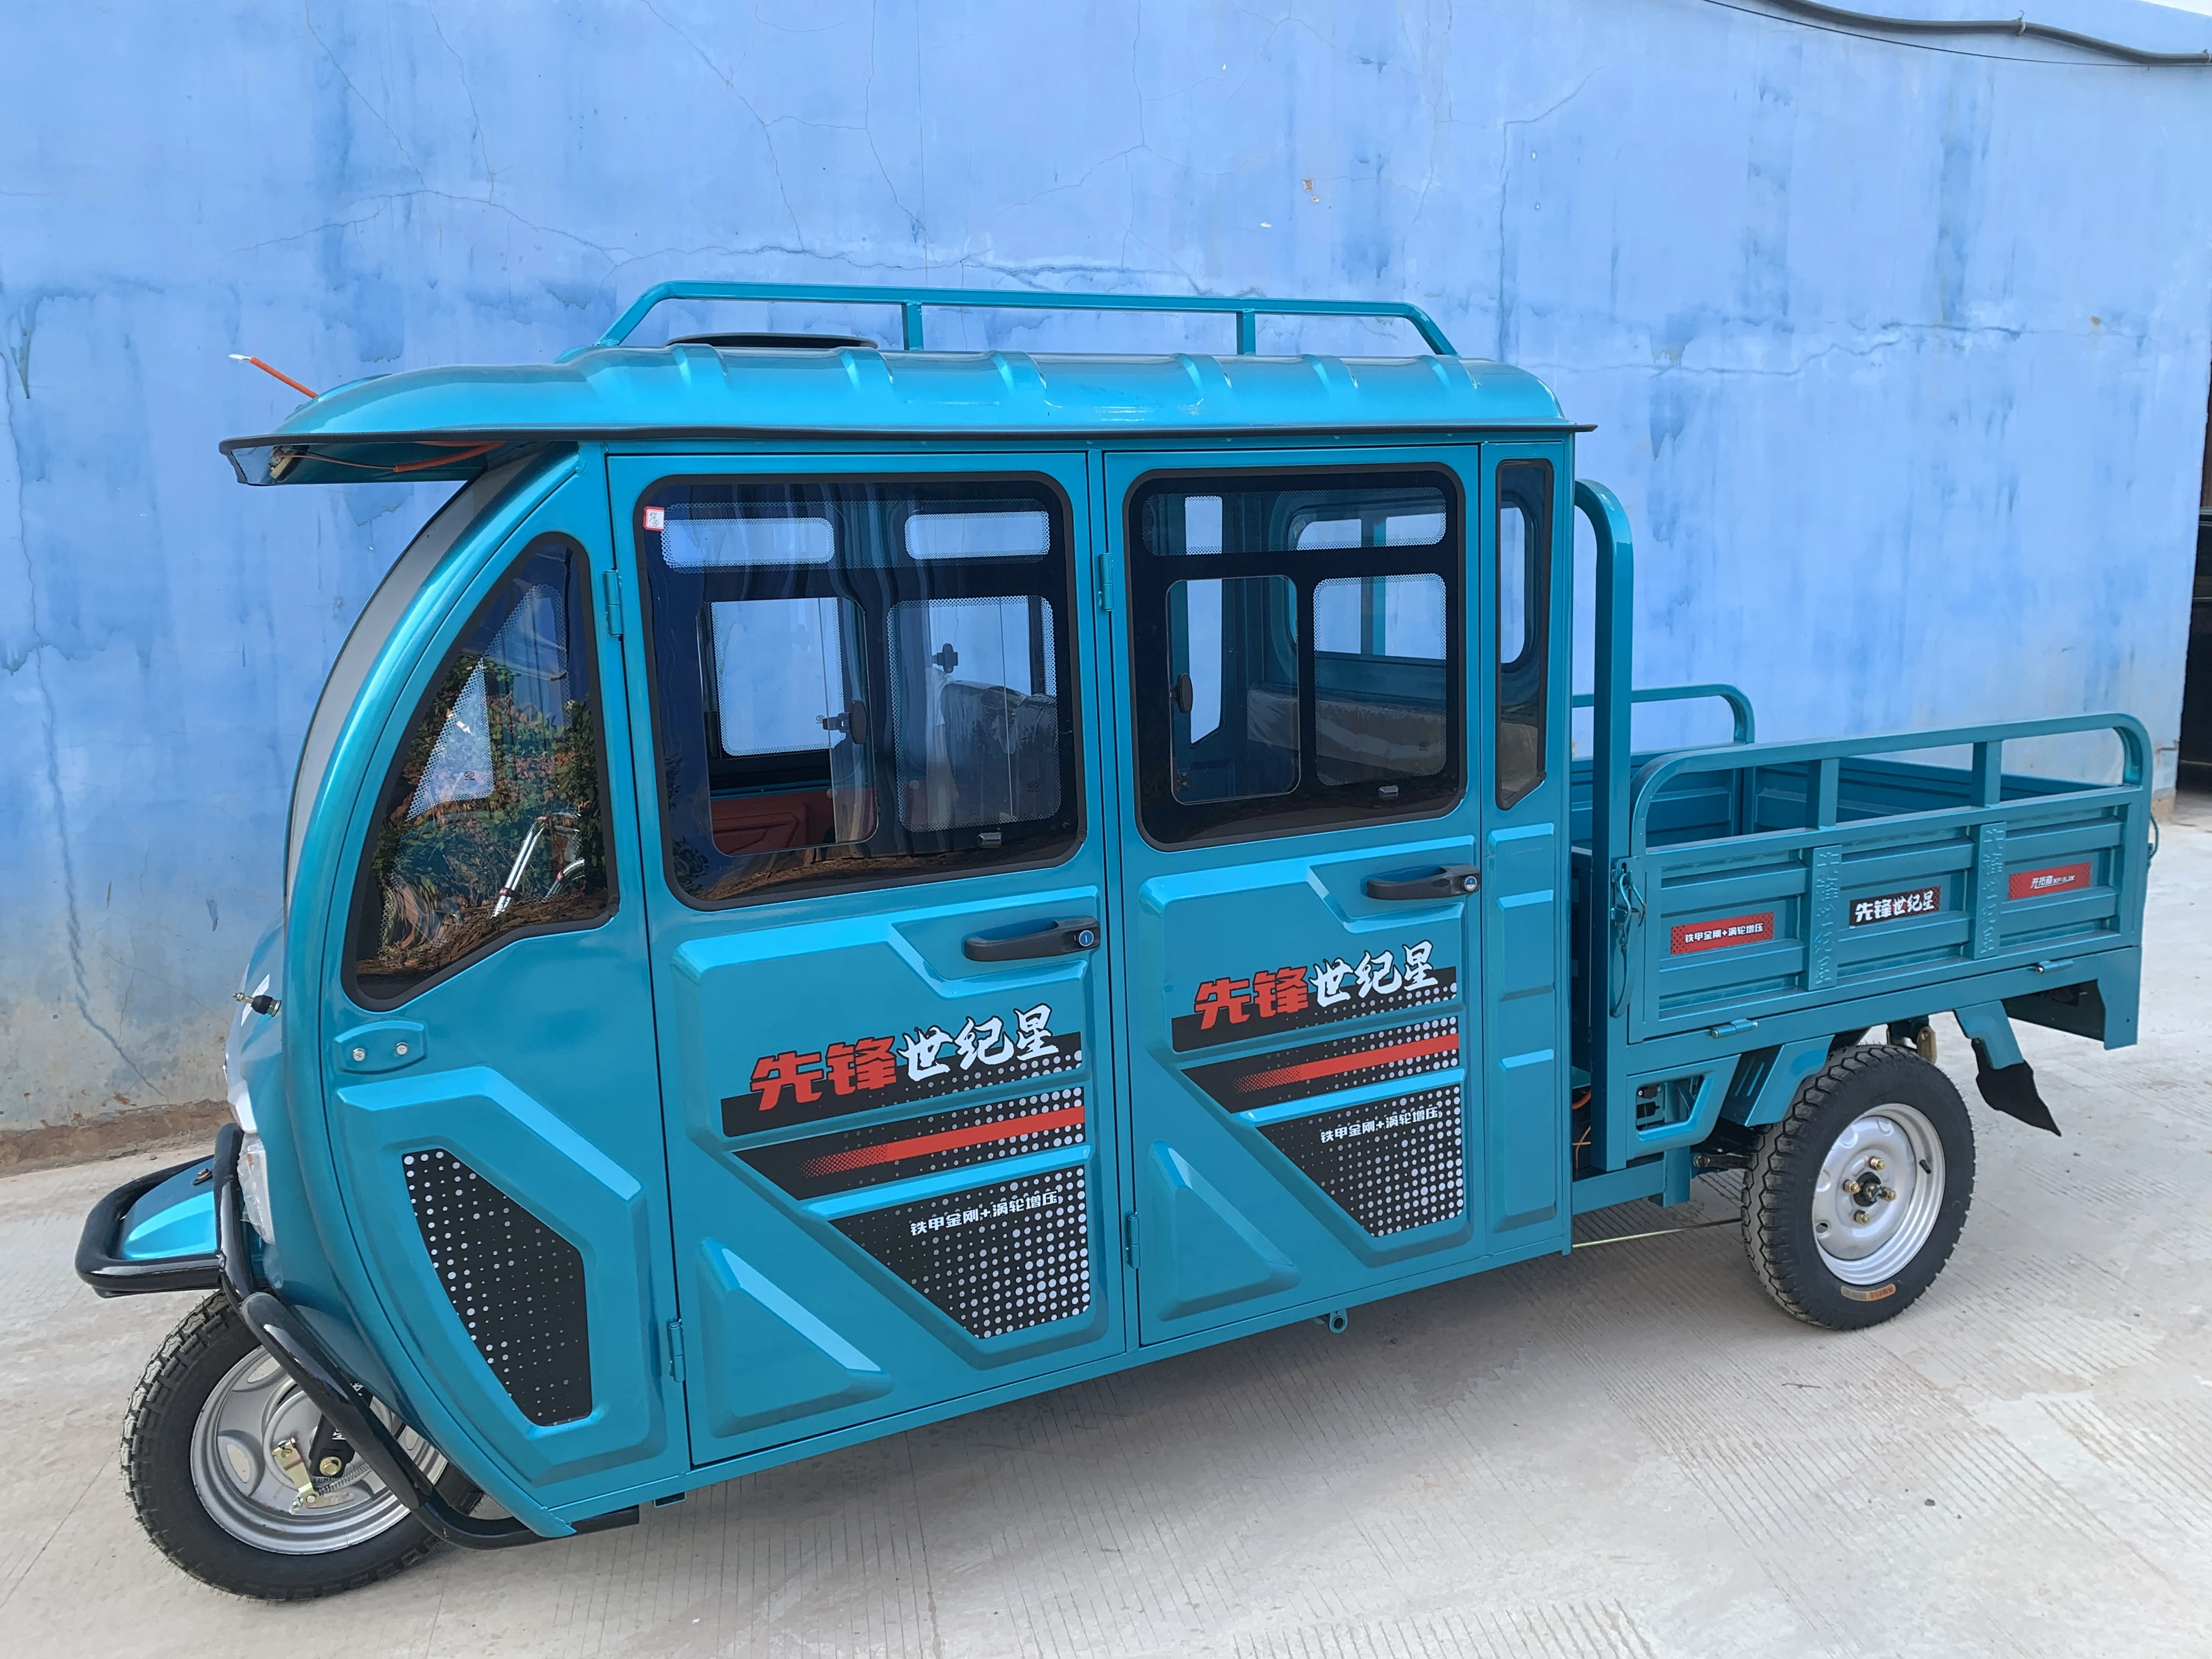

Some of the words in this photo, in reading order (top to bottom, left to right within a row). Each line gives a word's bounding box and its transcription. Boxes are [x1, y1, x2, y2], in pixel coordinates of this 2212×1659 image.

[1855, 890, 1935, 923] 先锋世纪星
[1685, 922, 1764, 944] 铁甲金刚+涡轮增压
[1193, 939, 1438, 1030] 先锋世纪星
[749, 1003, 1059, 1111] 先锋世纪星
[1320, 1106, 1440, 1143] 铁甲金刚+涡轮增压
[910, 1190, 1059, 1237] 铁甲金刚+涡轮增压
